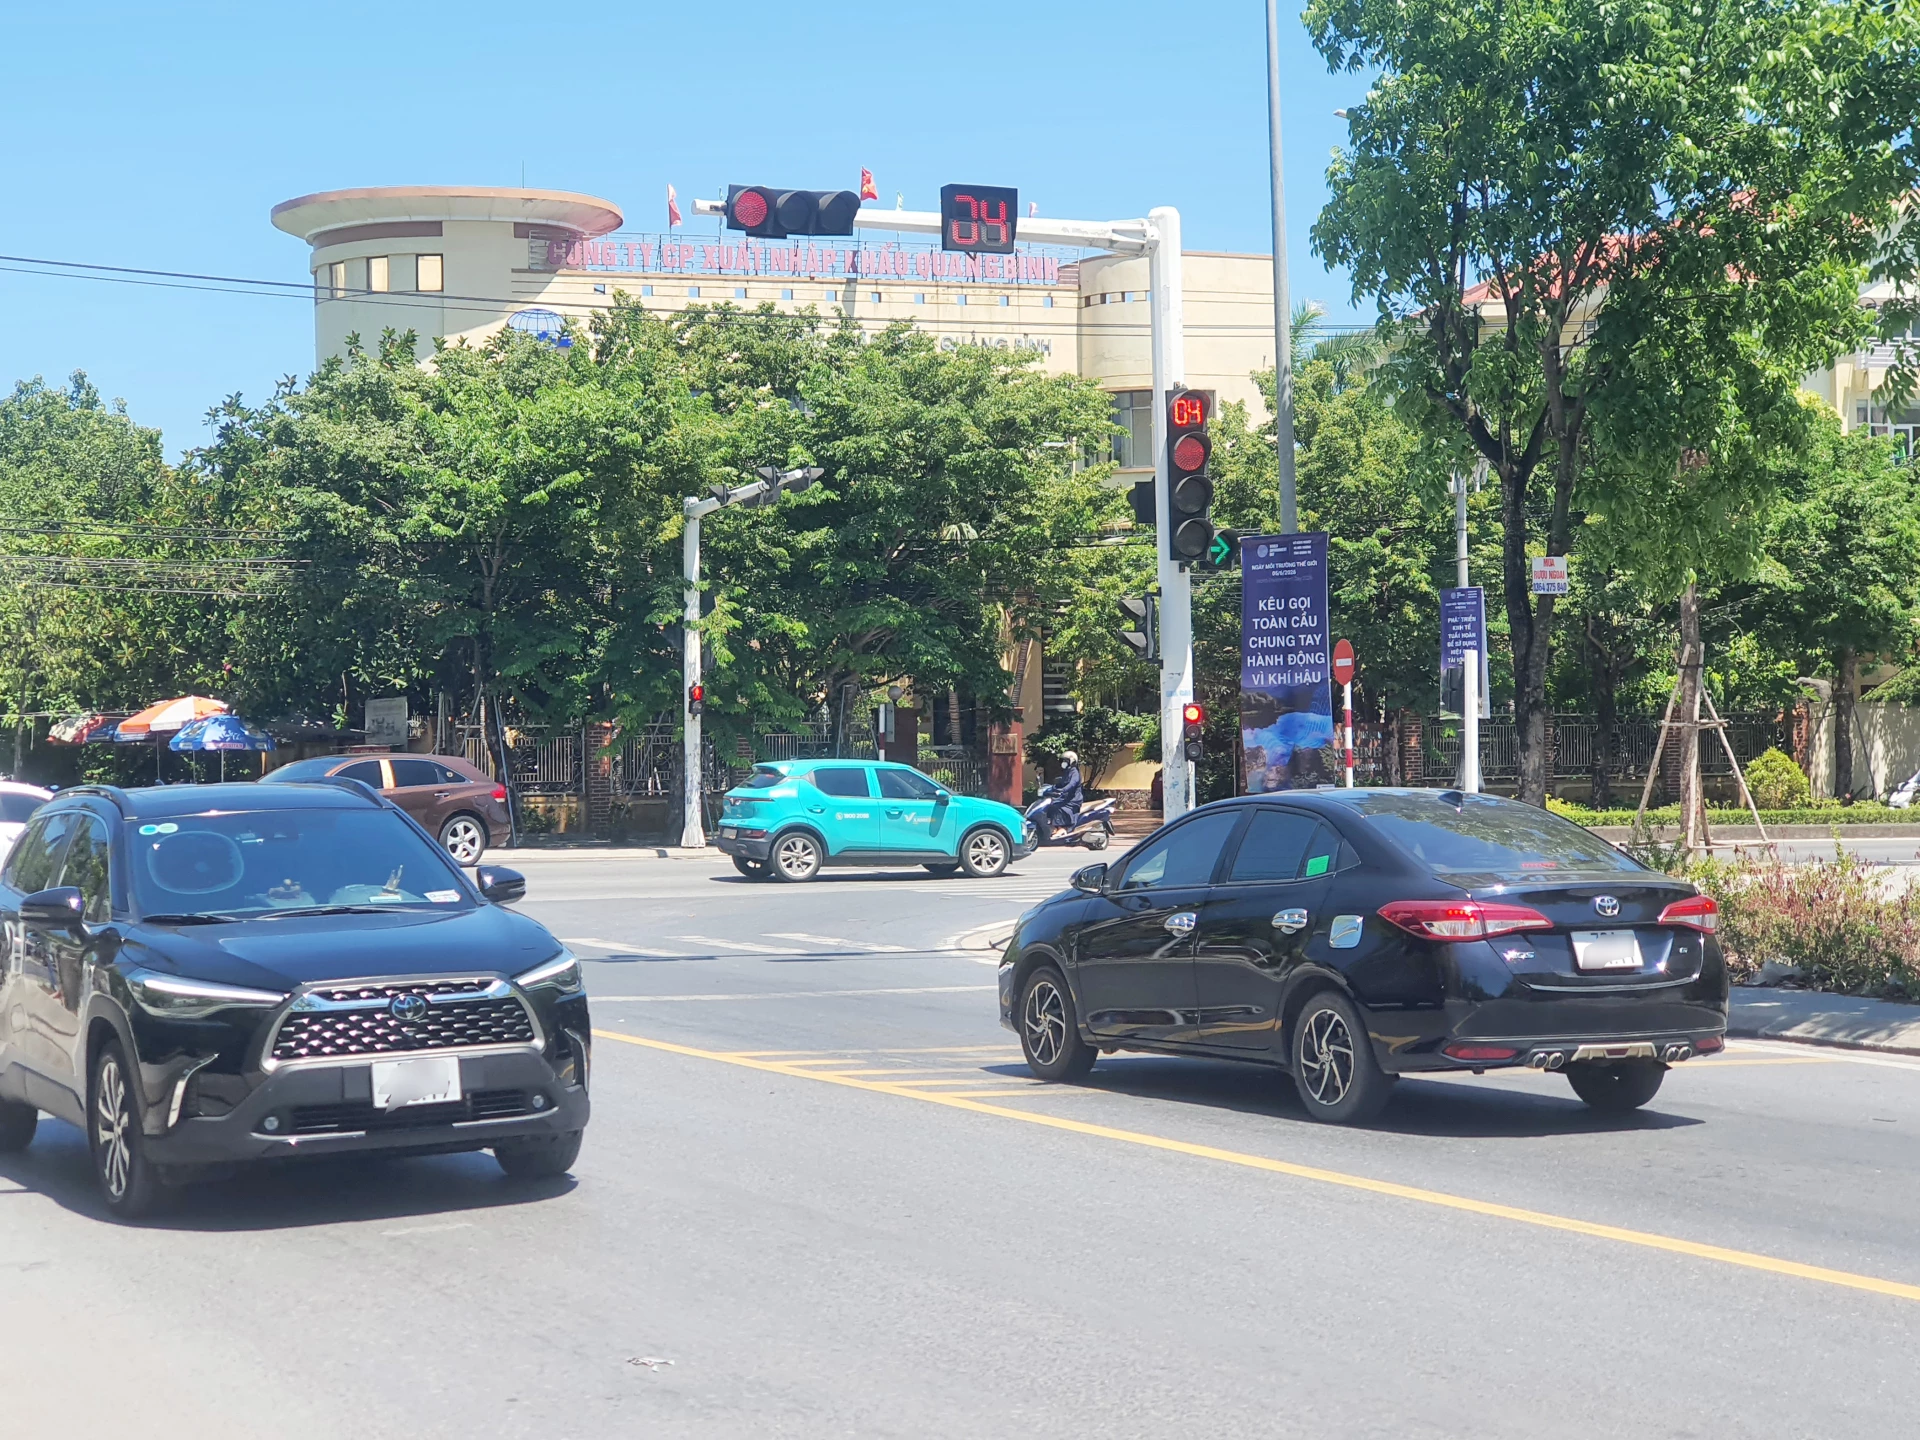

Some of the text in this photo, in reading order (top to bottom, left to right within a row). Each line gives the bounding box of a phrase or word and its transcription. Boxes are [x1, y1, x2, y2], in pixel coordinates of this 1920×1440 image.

[621, 241, 653, 267] TY
[662, 243, 694, 269] CP
[702, 237, 764, 271] XUẤT
[770, 242, 838, 279] NHẬP
[844, 242, 910, 276] KHẨU
[1174, 398, 1203, 425] 04
[1258, 596, 1311, 611] KÊU GỌI
[1252, 611, 1317, 630] TOÀN CẦU
[1249, 633, 1322, 649] CHUNG TAY
[1247, 650, 1325, 667] HÀNH ĐỘNG
[1252, 669, 1322, 686] VÌ KHÍ HẬU
